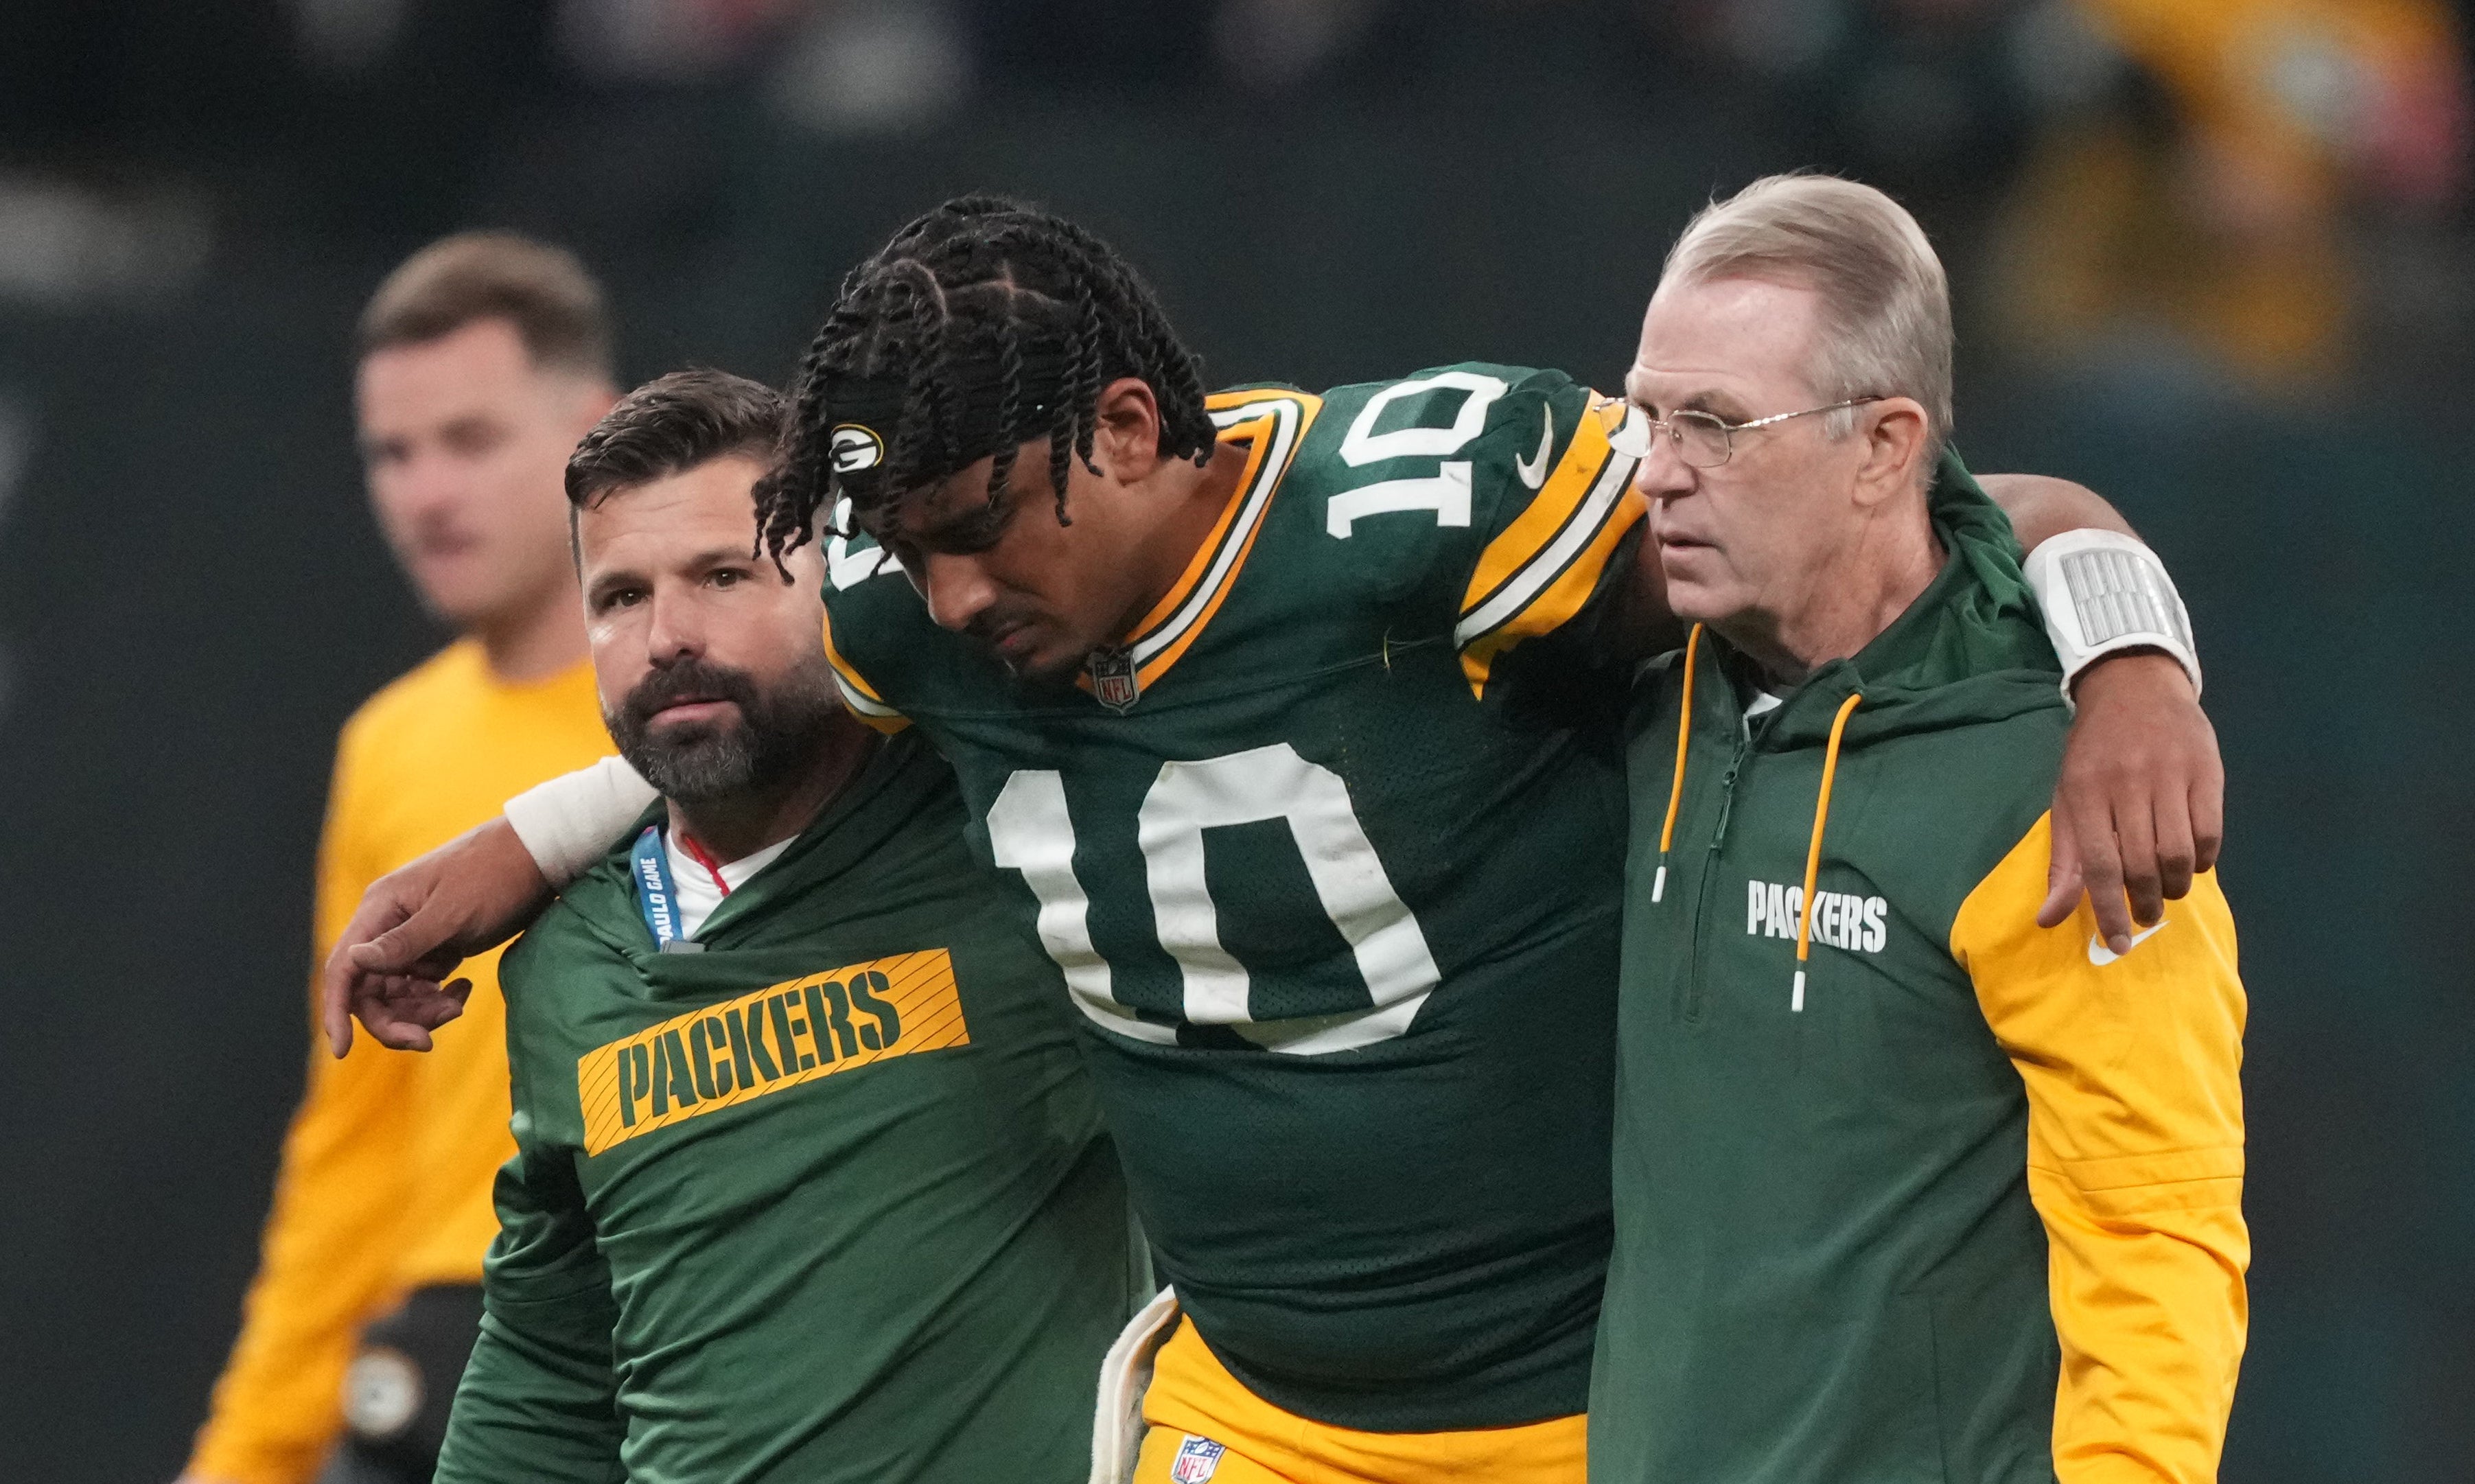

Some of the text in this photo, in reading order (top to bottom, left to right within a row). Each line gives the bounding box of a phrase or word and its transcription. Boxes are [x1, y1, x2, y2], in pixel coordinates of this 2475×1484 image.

[829, 429, 877, 473] G
[1326, 371, 1509, 540] 10
[1101, 676, 1133, 704] NFL
[640, 858, 663, 890] GAME
[986, 742, 1441, 1055] 10
[1747, 879, 1887, 953] PACKERS
[617, 971, 901, 1128] PACKERS
[1178, 1457, 1207, 1480] NFL
